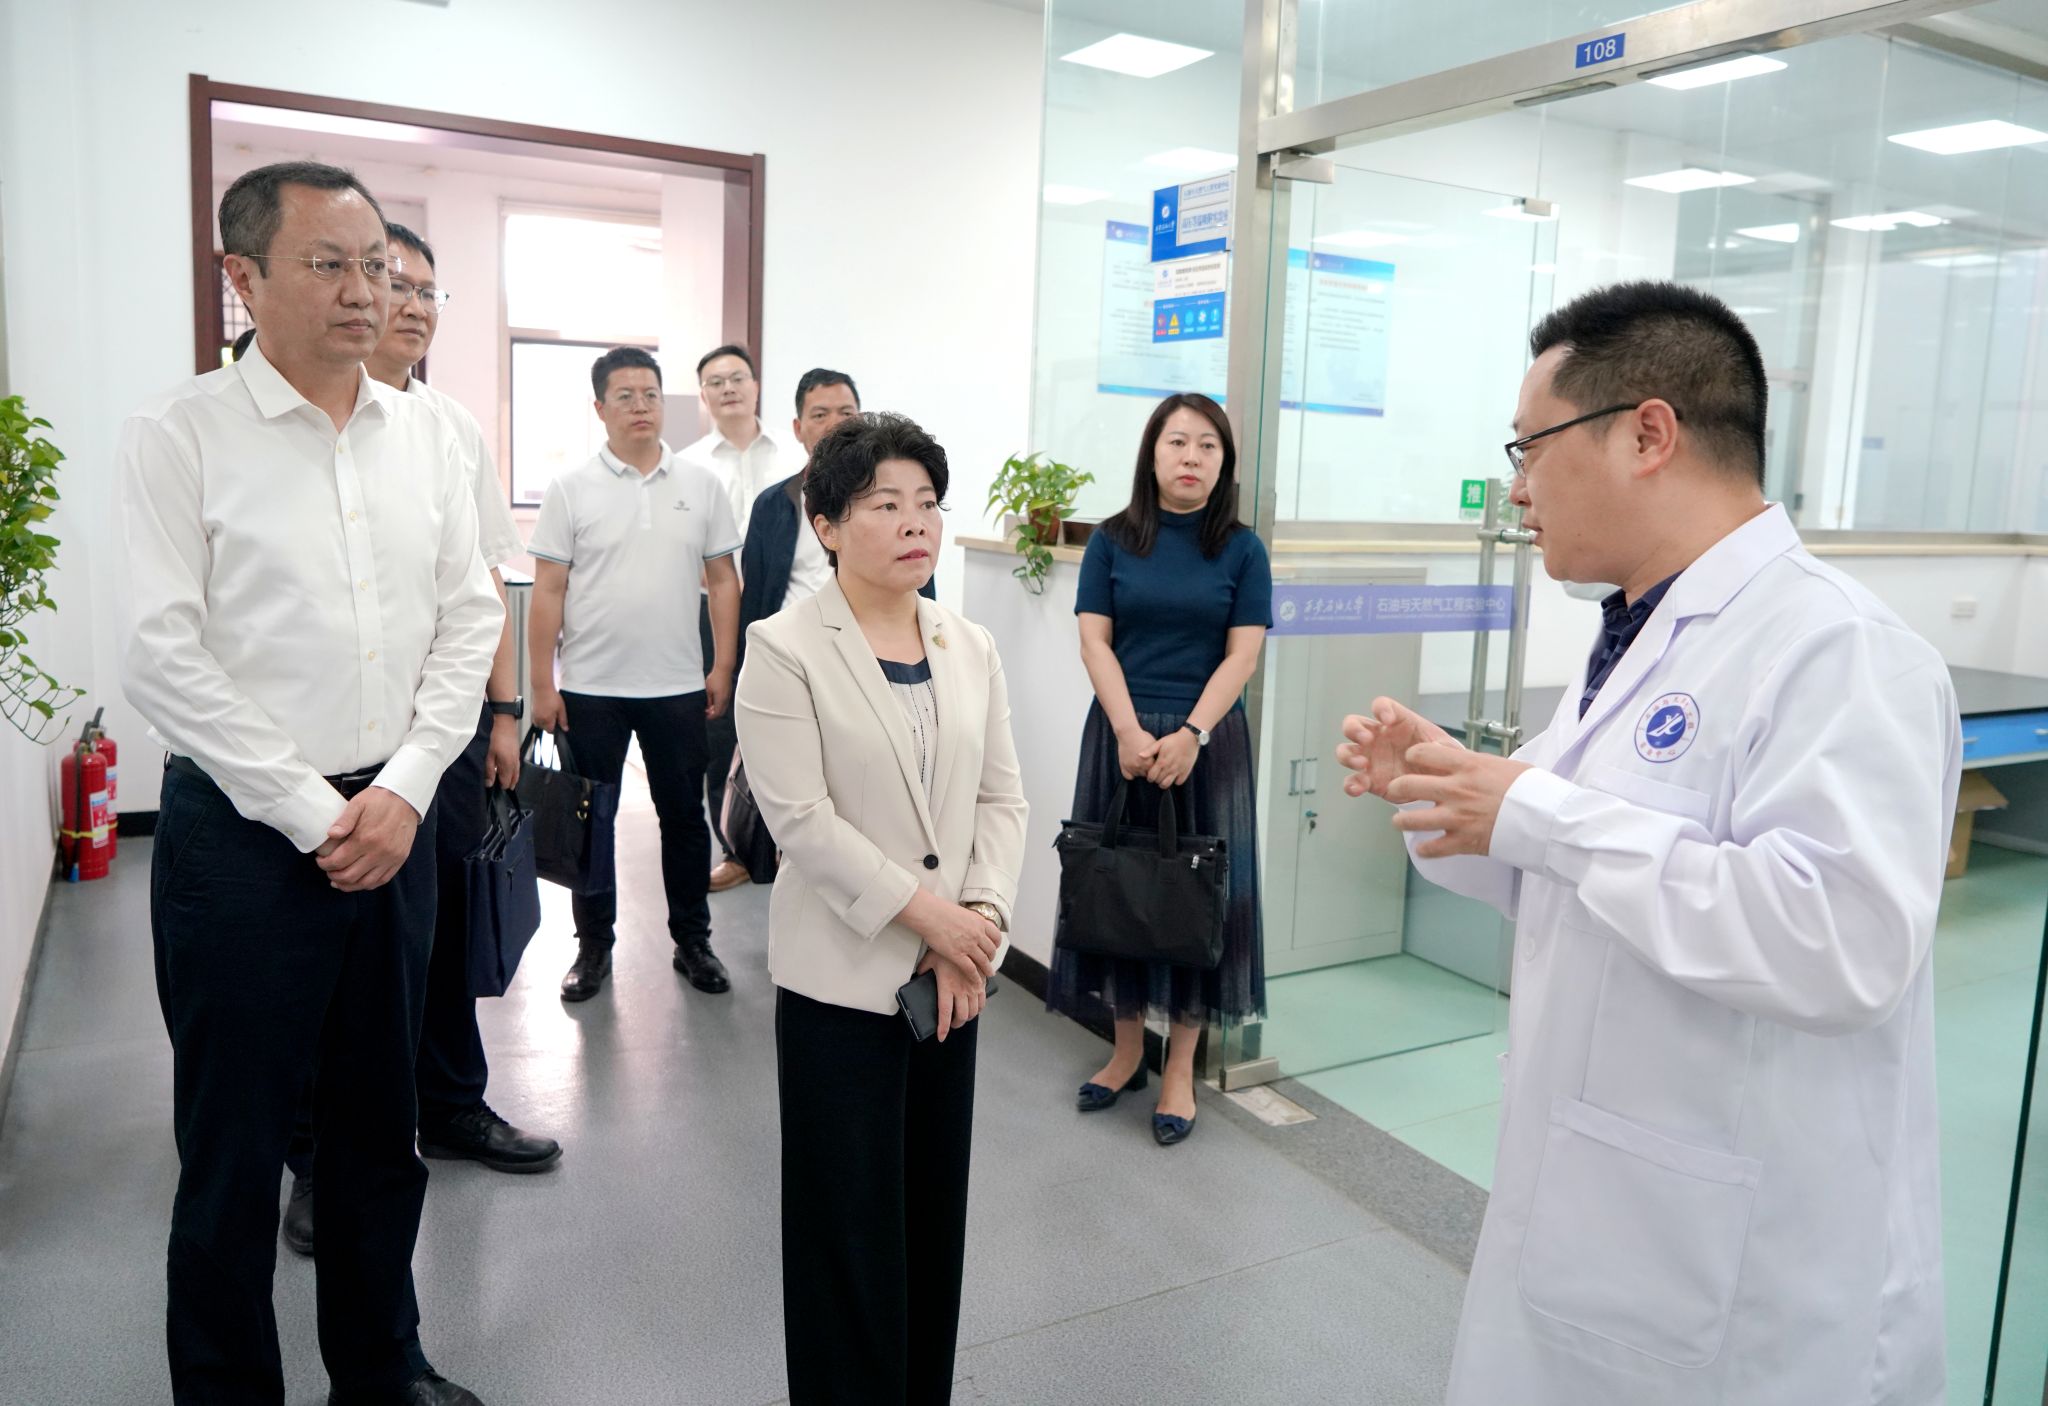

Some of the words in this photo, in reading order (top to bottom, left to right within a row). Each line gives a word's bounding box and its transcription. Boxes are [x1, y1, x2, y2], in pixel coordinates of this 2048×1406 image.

[1584, 39, 1616, 62] 108
[1466, 483, 1481, 504] 推
[1303, 595, 1364, 614] 西安石油大学
[1376, 597, 1505, 613] 石油与天然气工程实验中心
